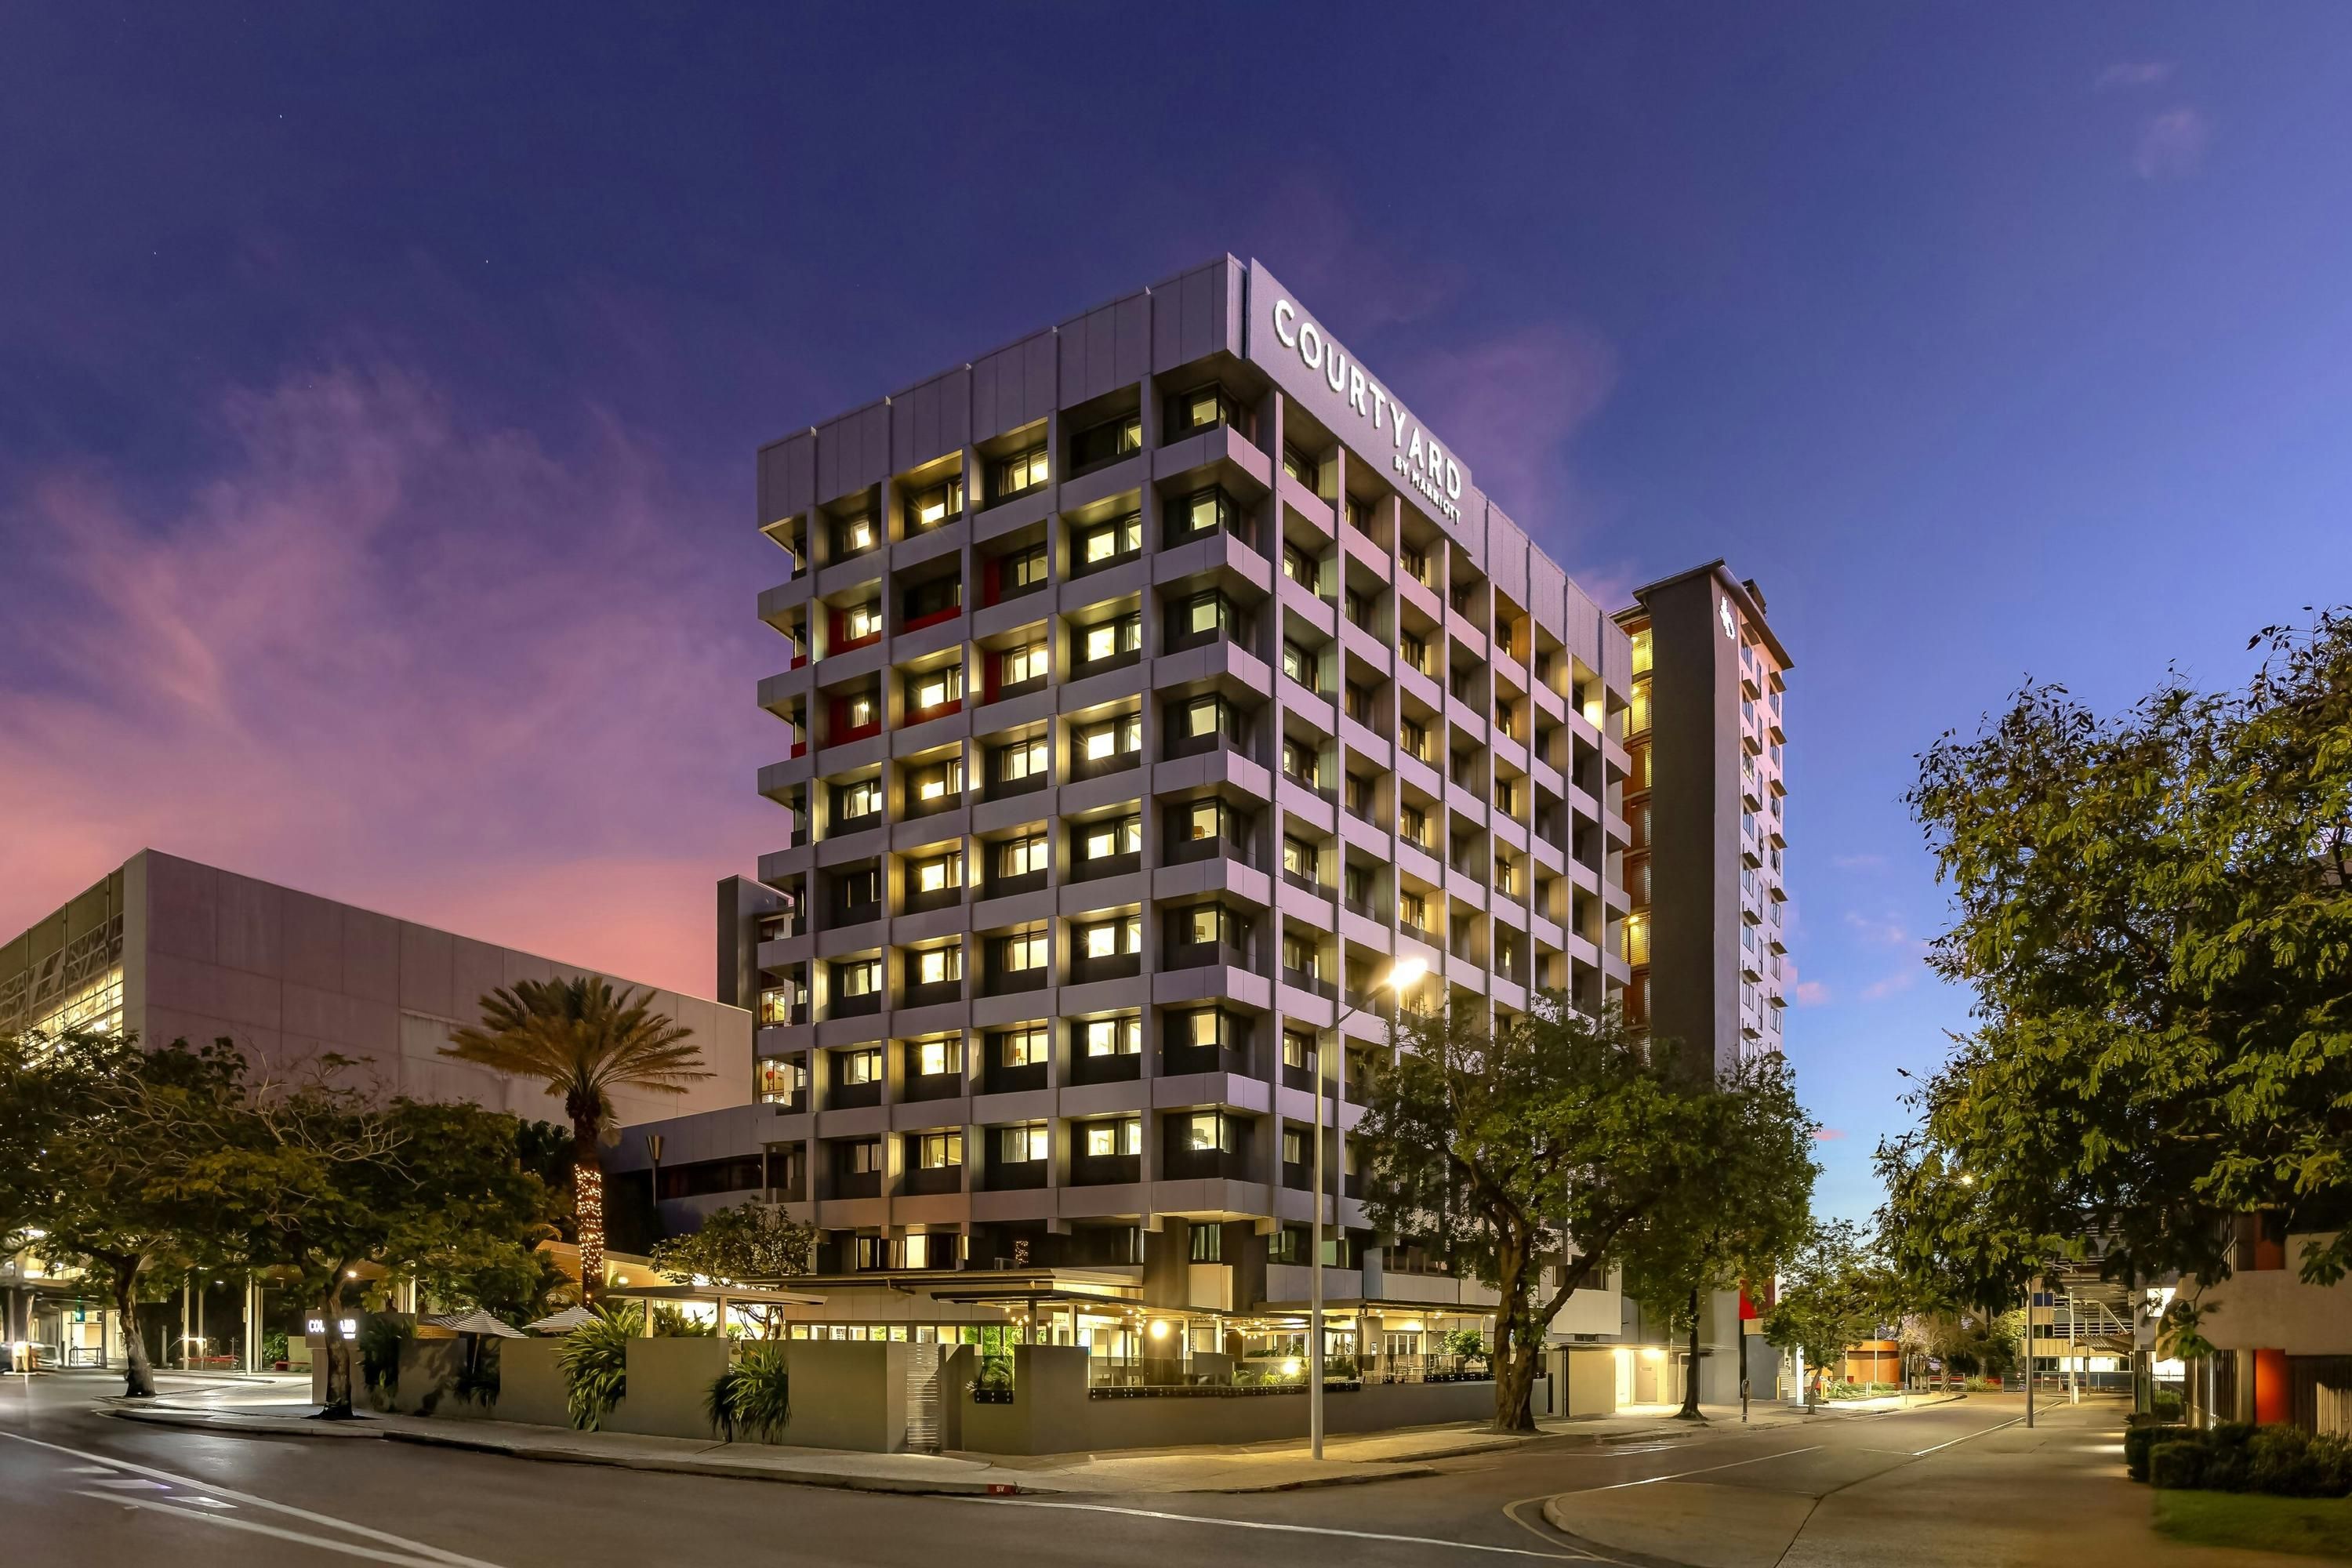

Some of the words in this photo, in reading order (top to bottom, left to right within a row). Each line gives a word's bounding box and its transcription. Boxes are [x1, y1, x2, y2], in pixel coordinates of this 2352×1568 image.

[1276, 299, 1461, 499] COURTYARD
[1395, 454, 1409, 475] BY
[1412, 468, 1461, 524] MARRIOTT
